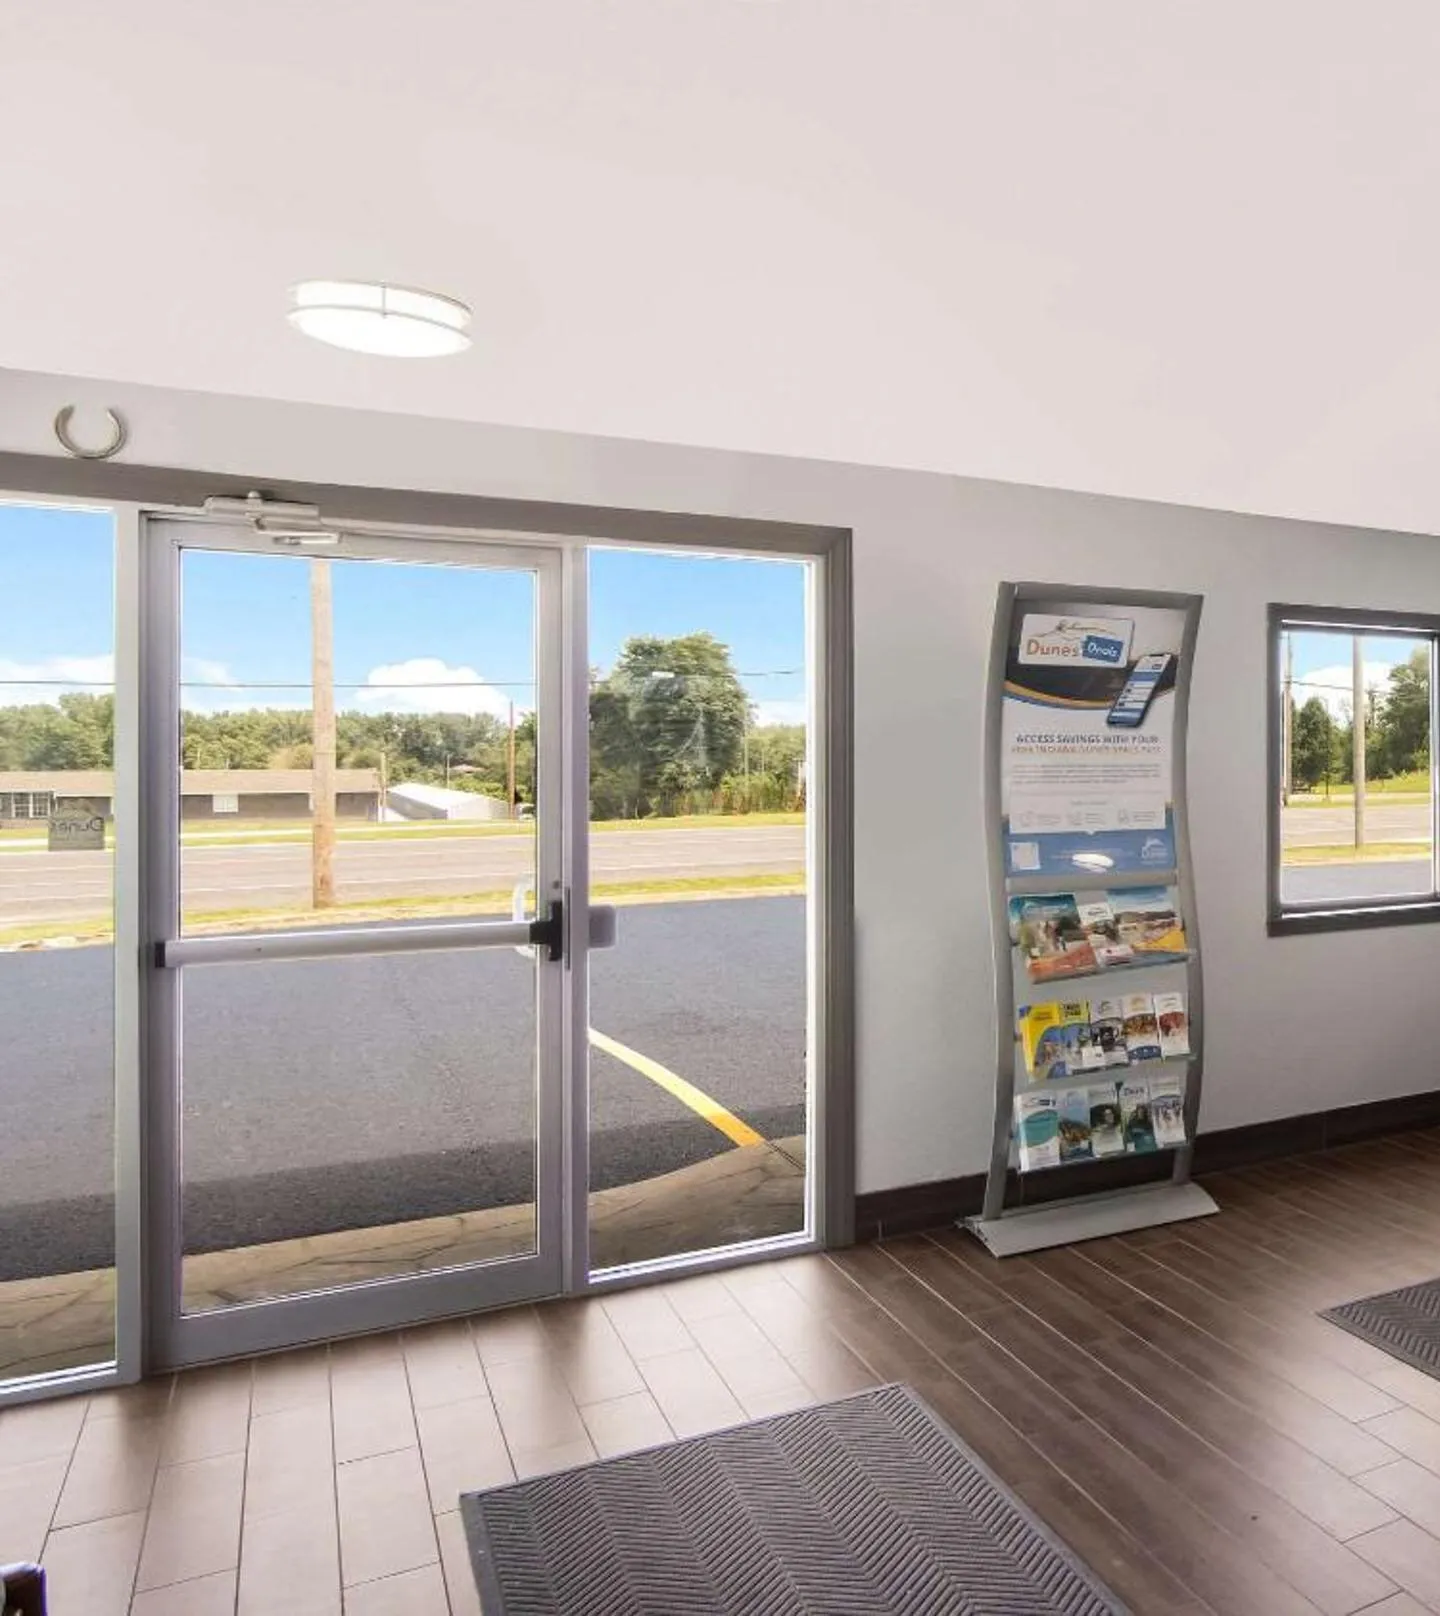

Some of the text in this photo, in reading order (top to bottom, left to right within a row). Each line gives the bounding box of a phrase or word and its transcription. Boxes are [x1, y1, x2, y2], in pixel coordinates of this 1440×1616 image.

[1026, 638, 1079, 657] Dunes
[1016, 734, 1055, 744] ACCESS
[1056, 734, 1102, 744] SAVINGS
